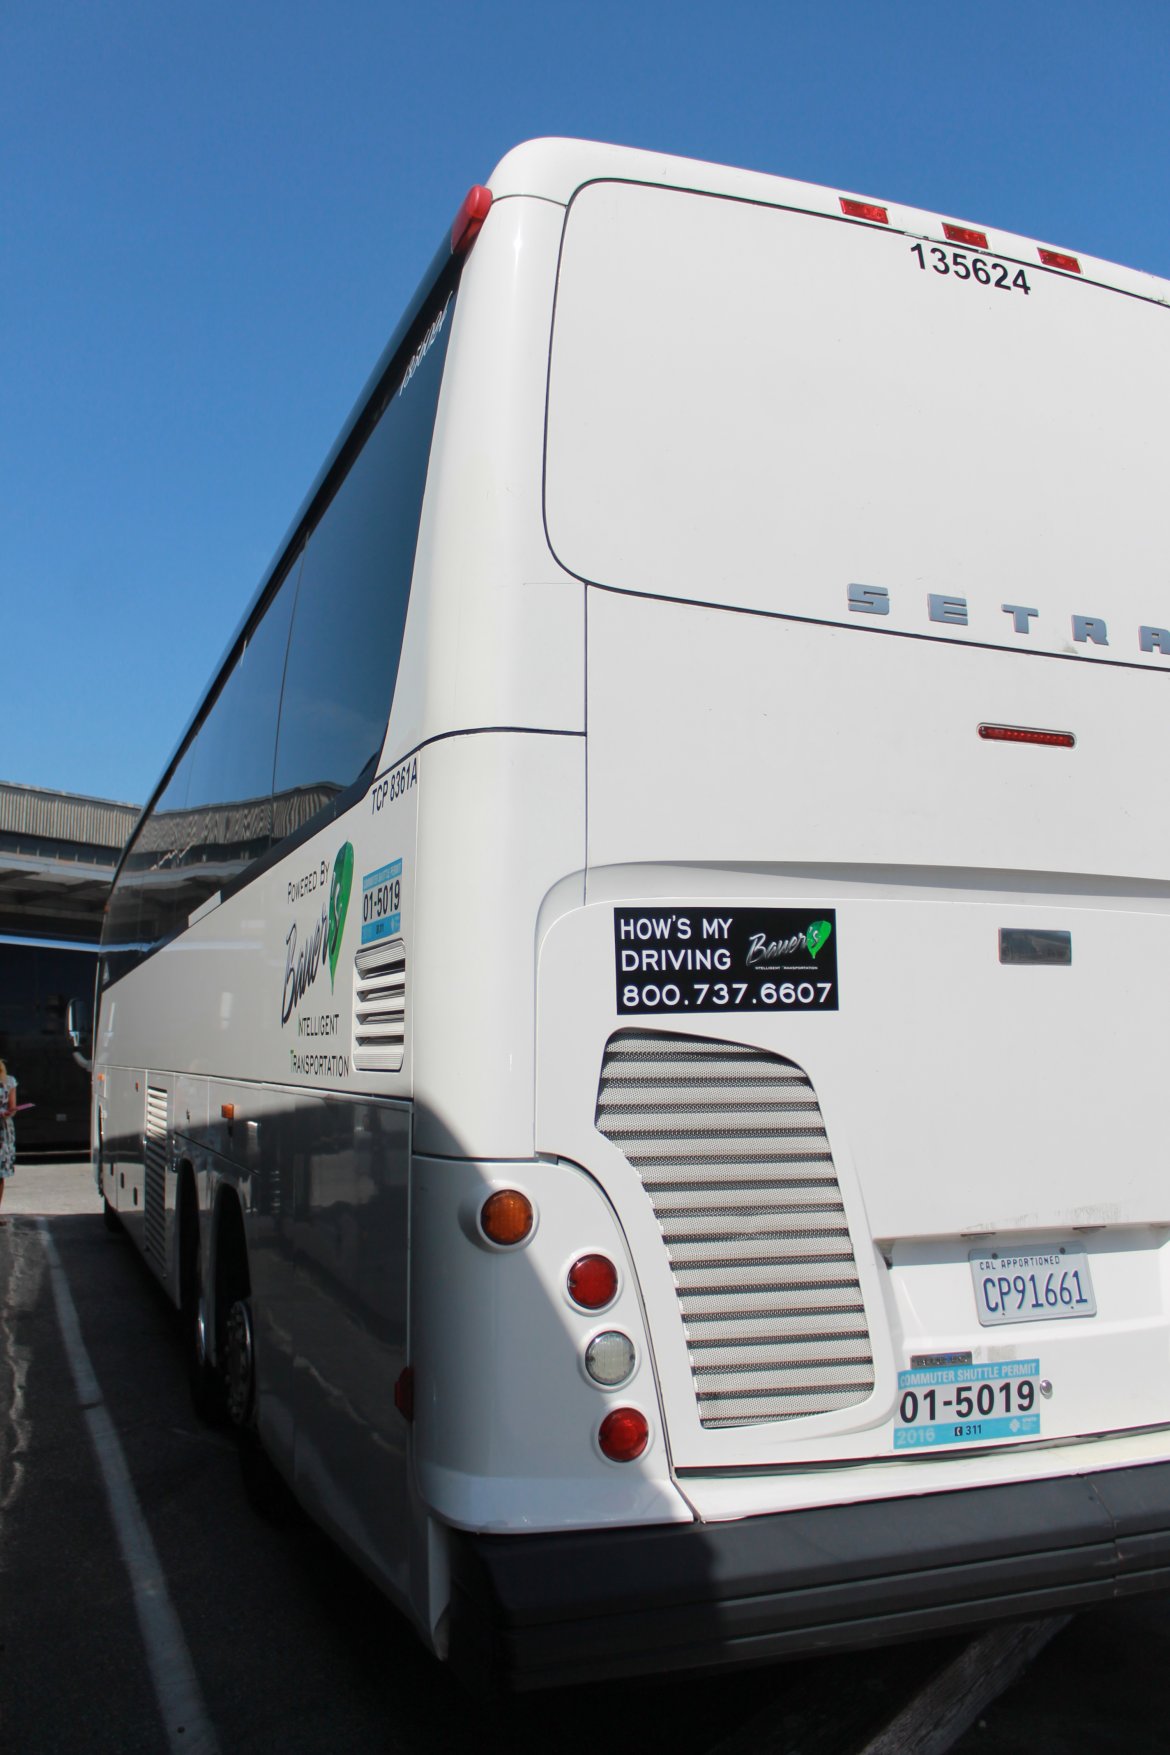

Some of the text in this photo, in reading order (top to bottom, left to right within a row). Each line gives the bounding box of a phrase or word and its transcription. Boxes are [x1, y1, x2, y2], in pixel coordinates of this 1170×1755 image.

[910, 243, 1031, 295] 135624
[847, 583, 1170, 655] SETRA
[372, 757, 417, 815] TCP 8361A
[363, 879, 400, 922] 01-5019
[620, 915, 733, 940] HOW'S MY
[621, 949, 731, 972] DRIVING
[623, 982, 832, 1007] 800.737.6607
[980, 1255, 1060, 1270] CAL APPORTIONED
[983, 1270, 1088, 1312] CP91661
[900, 1362, 1037, 1386] COMMUTER SHUTTLE PERMIT
[900, 1379, 1035, 1424] 01-5019
[897, 1424, 982, 1445] 2016 311
